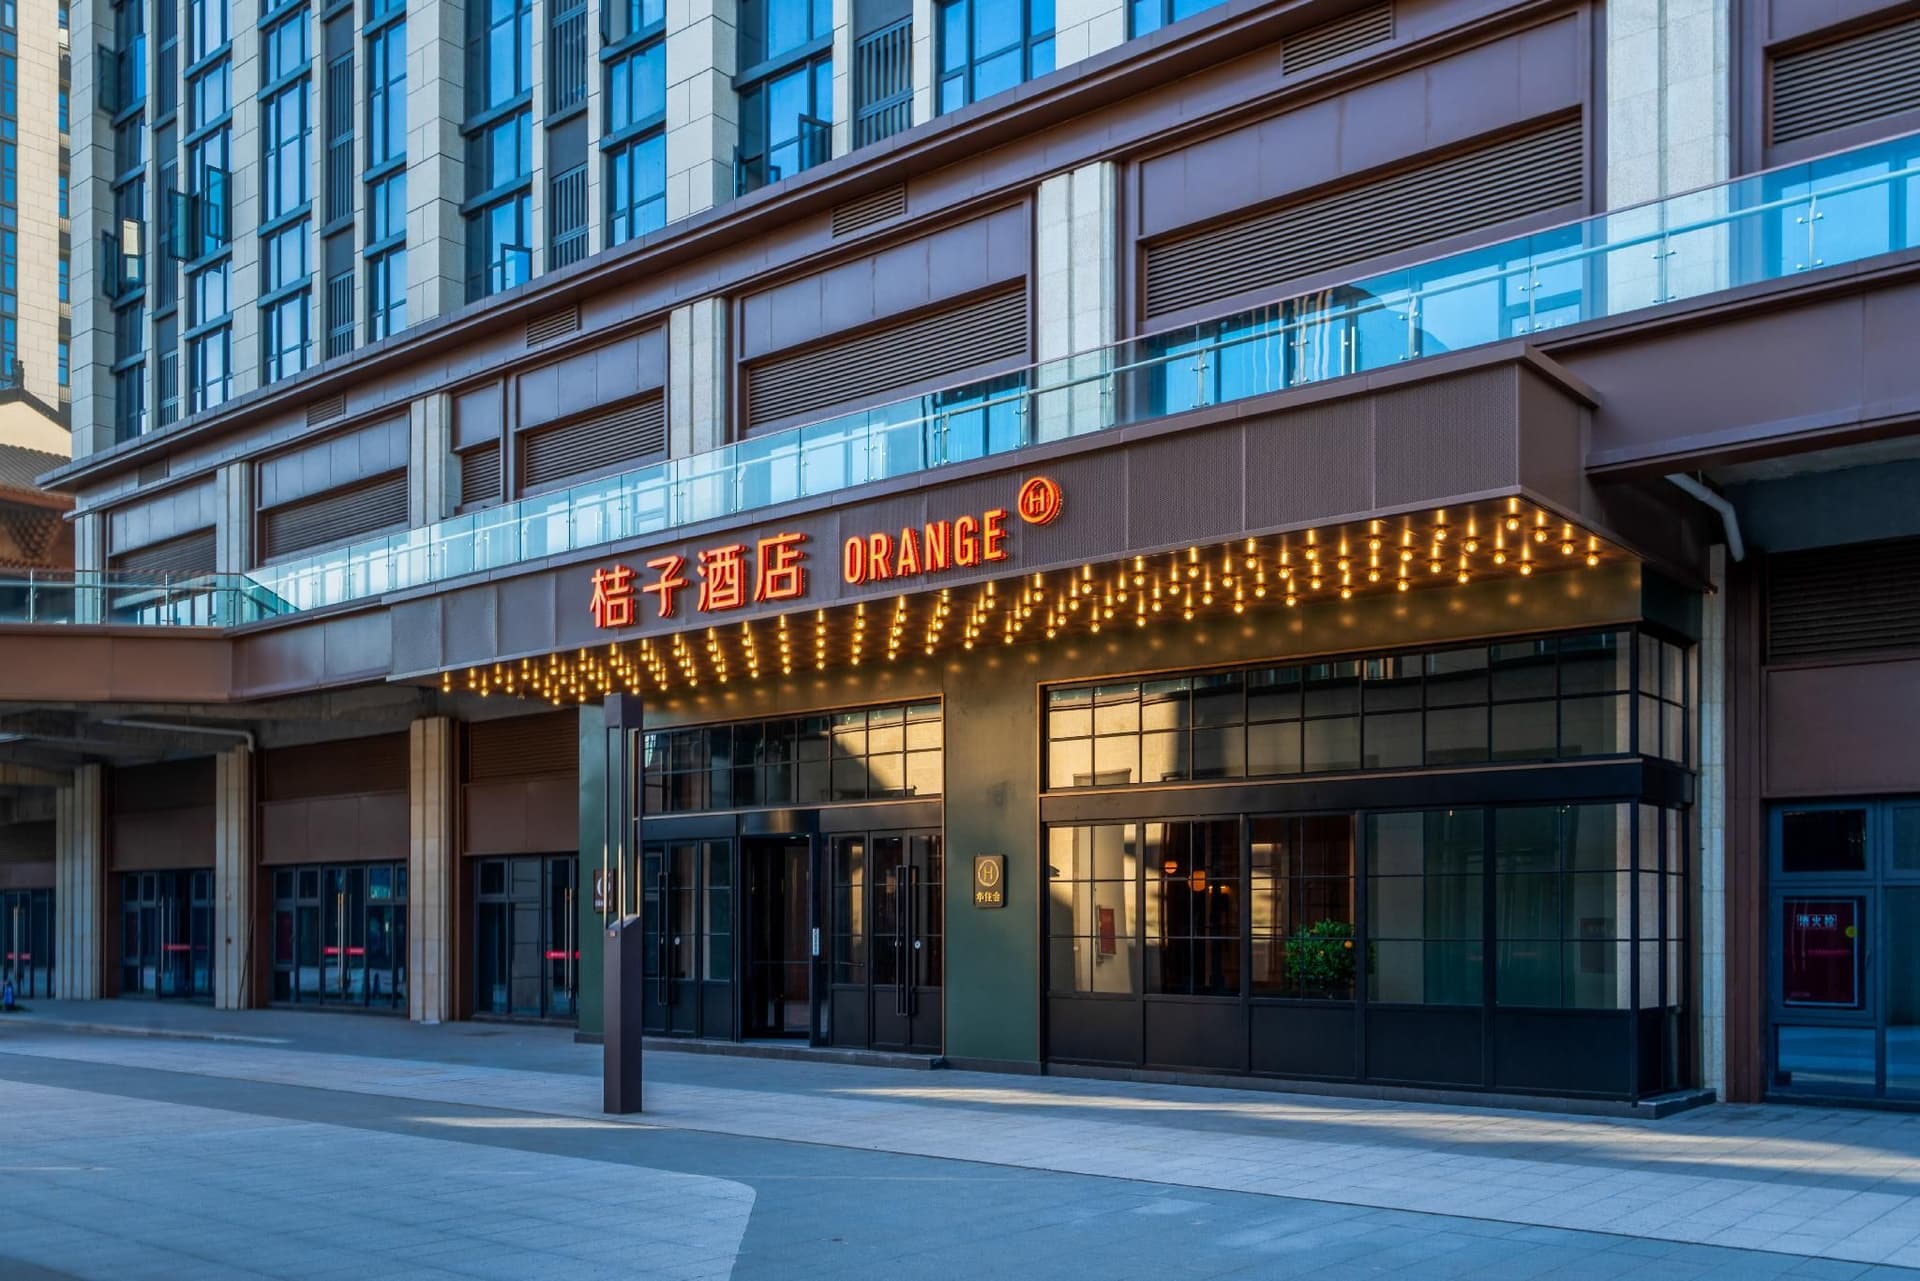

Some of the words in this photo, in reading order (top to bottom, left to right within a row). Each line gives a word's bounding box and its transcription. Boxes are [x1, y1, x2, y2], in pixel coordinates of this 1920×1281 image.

[590, 532, 806, 629] 桔子酒店
[843, 508, 1008, 586] ORANGE
